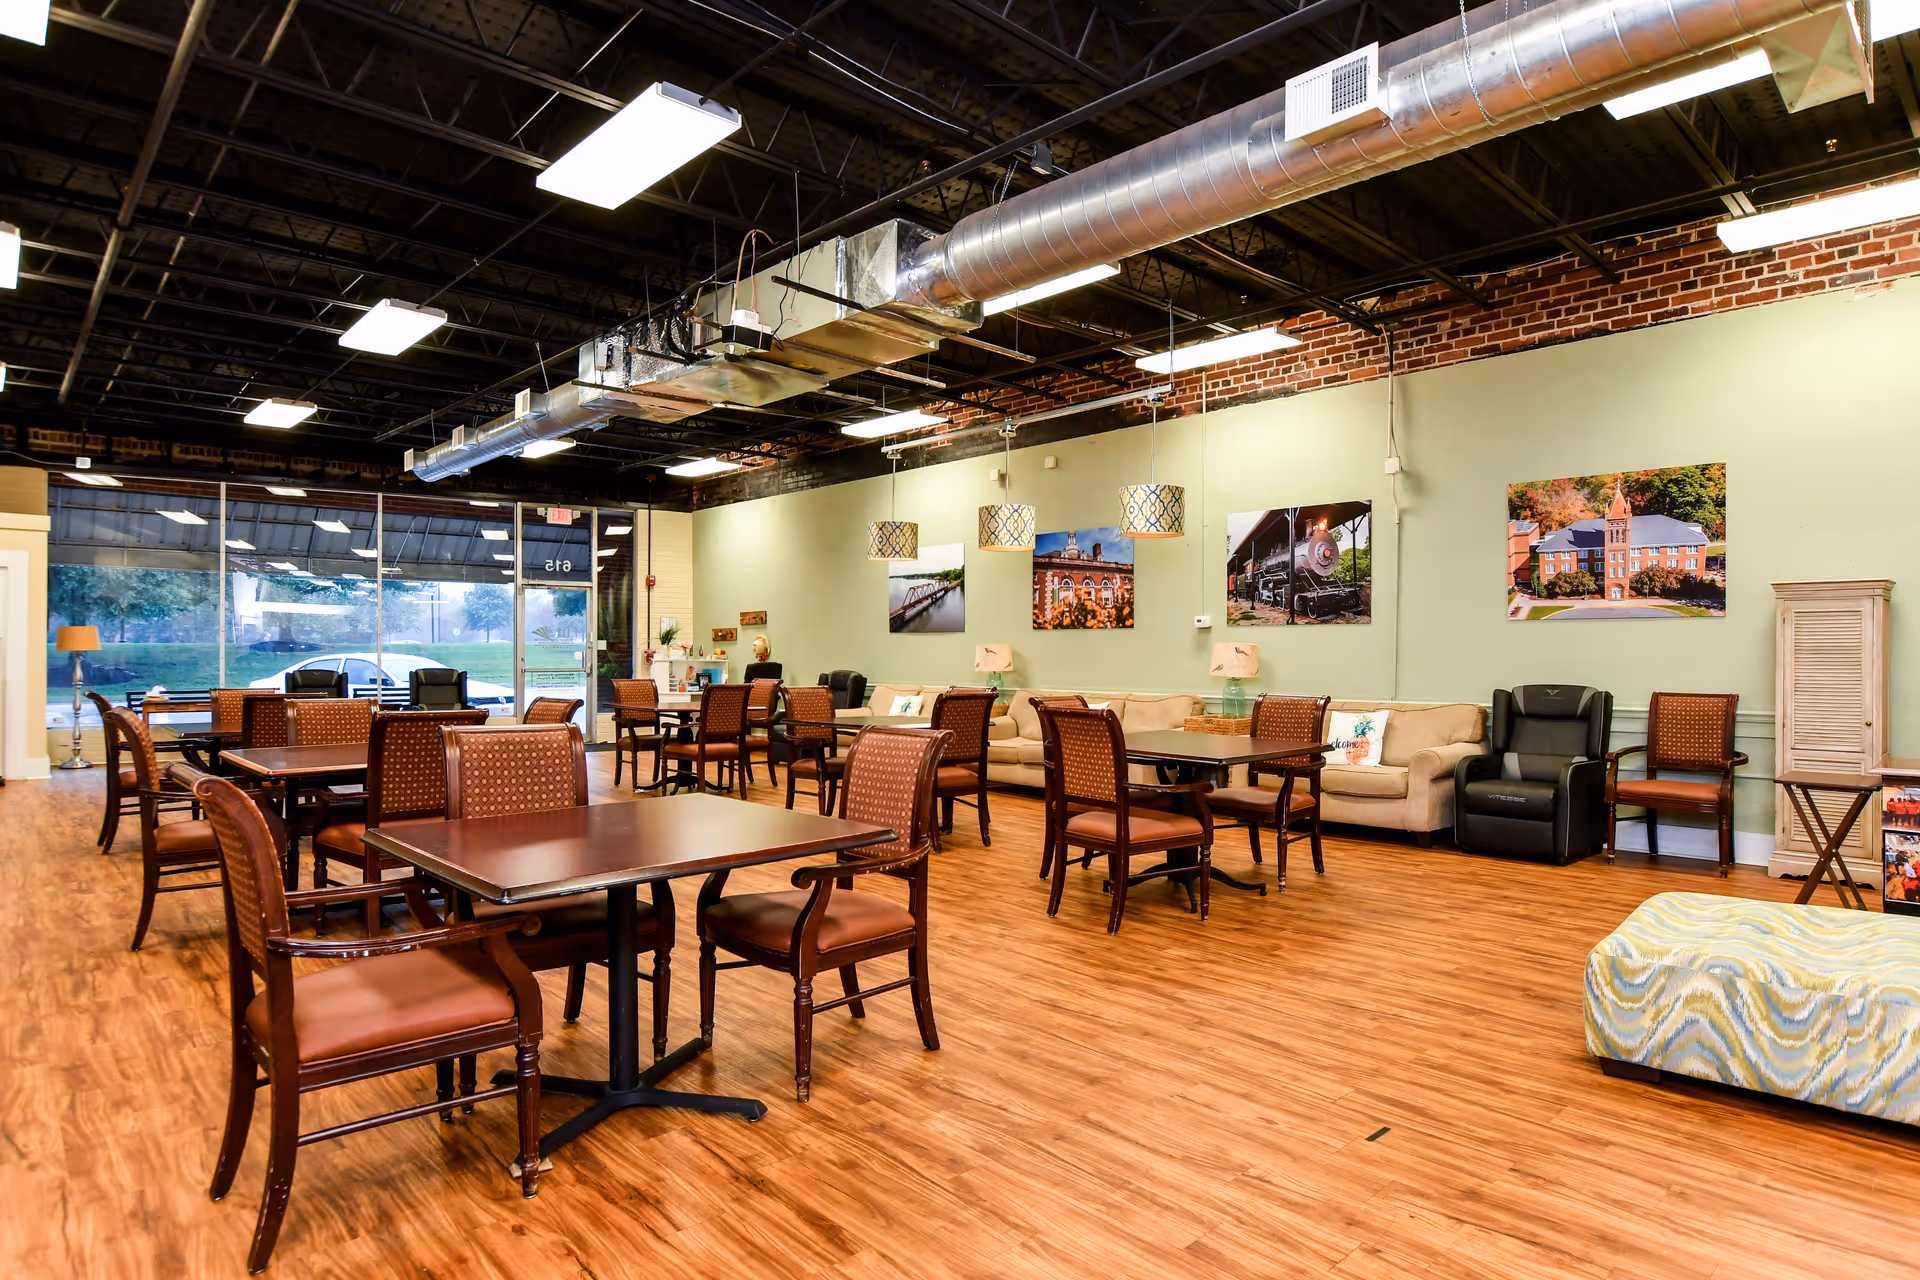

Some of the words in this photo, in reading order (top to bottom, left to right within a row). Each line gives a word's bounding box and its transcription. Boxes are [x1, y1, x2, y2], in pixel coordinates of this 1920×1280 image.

[552, 509, 569, 522] EXIT
[1327, 737, 1361, 749] elcome
[1487, 794, 1527, 803] VITESSE
